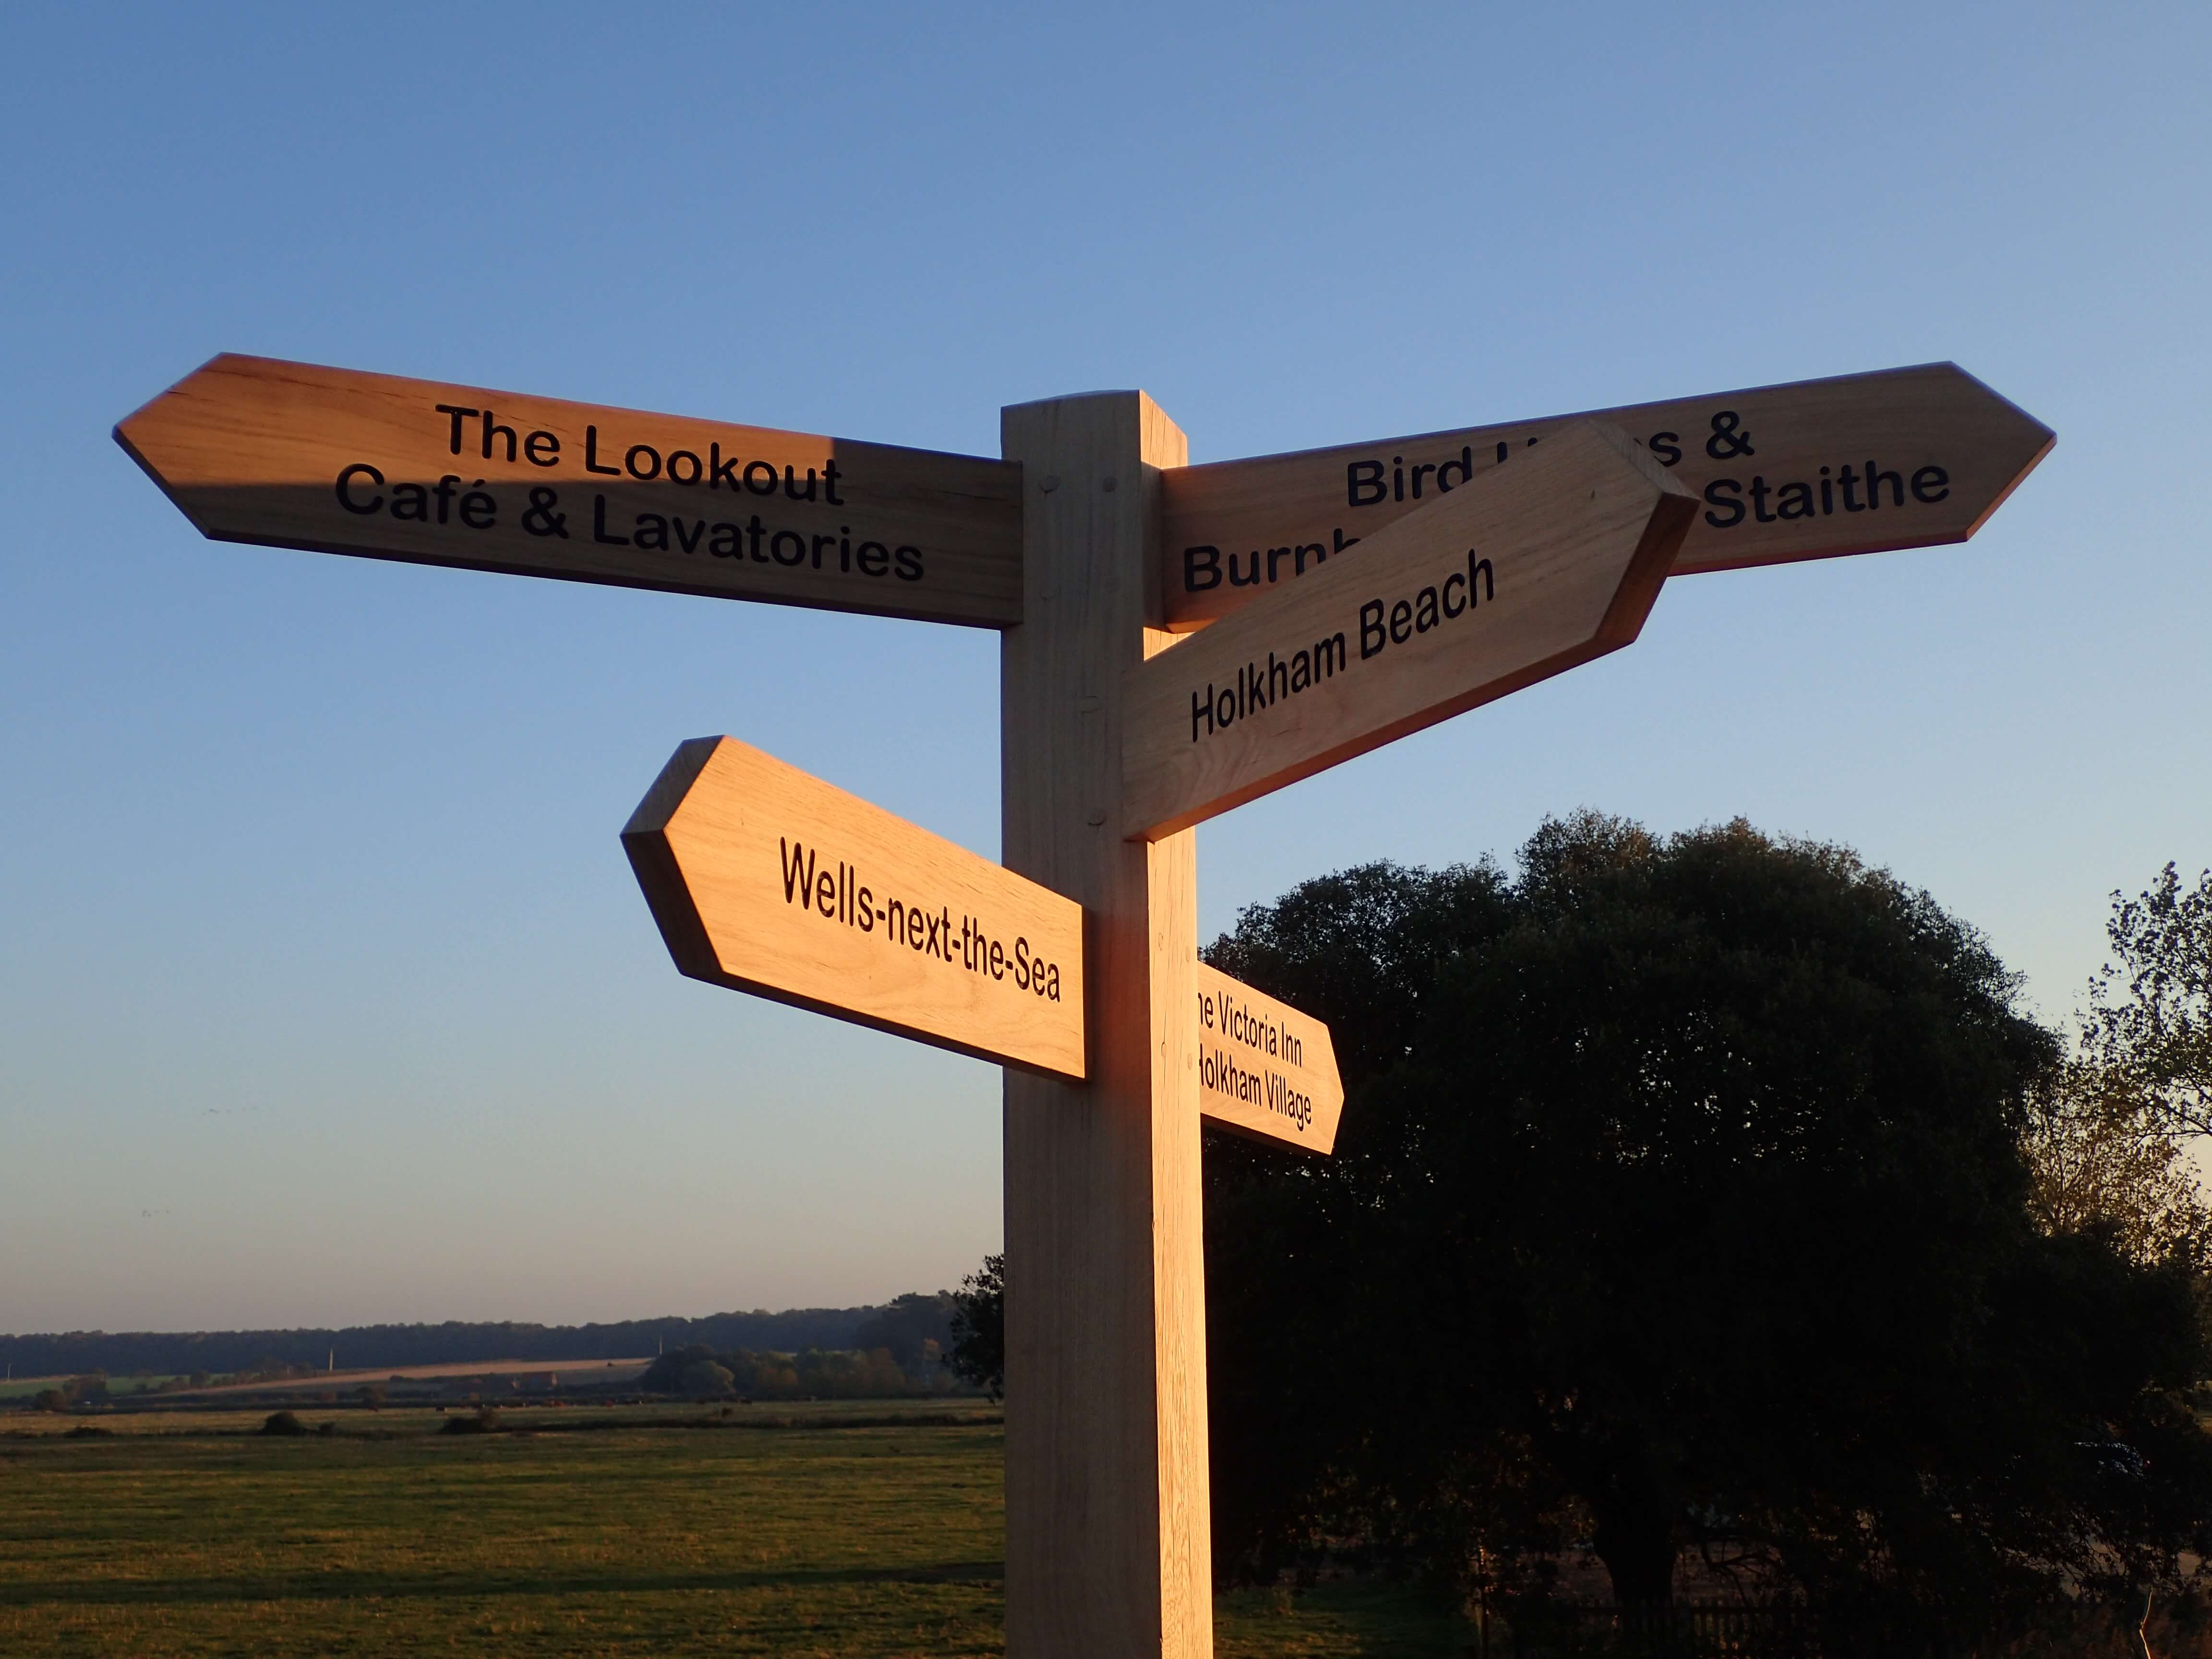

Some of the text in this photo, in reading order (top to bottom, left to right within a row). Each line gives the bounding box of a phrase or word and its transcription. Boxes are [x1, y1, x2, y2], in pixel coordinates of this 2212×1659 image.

[435, 404, 844, 506] The Lookout
[1347, 446, 1472, 507] Bird
[1706, 410, 1755, 460] &
[1705, 460, 1950, 528] Staithe
[336, 463, 924, 581] Café & Lavatories
[1192, 549, 1494, 743] Holkham Beach
[780, 836, 1060, 1003] Wells-next-the-Sea
[1218, 990, 1277, 1057] Victoria
[1282, 1022, 1302, 1068] Inn
[1265, 1069, 1312, 1132] Village
